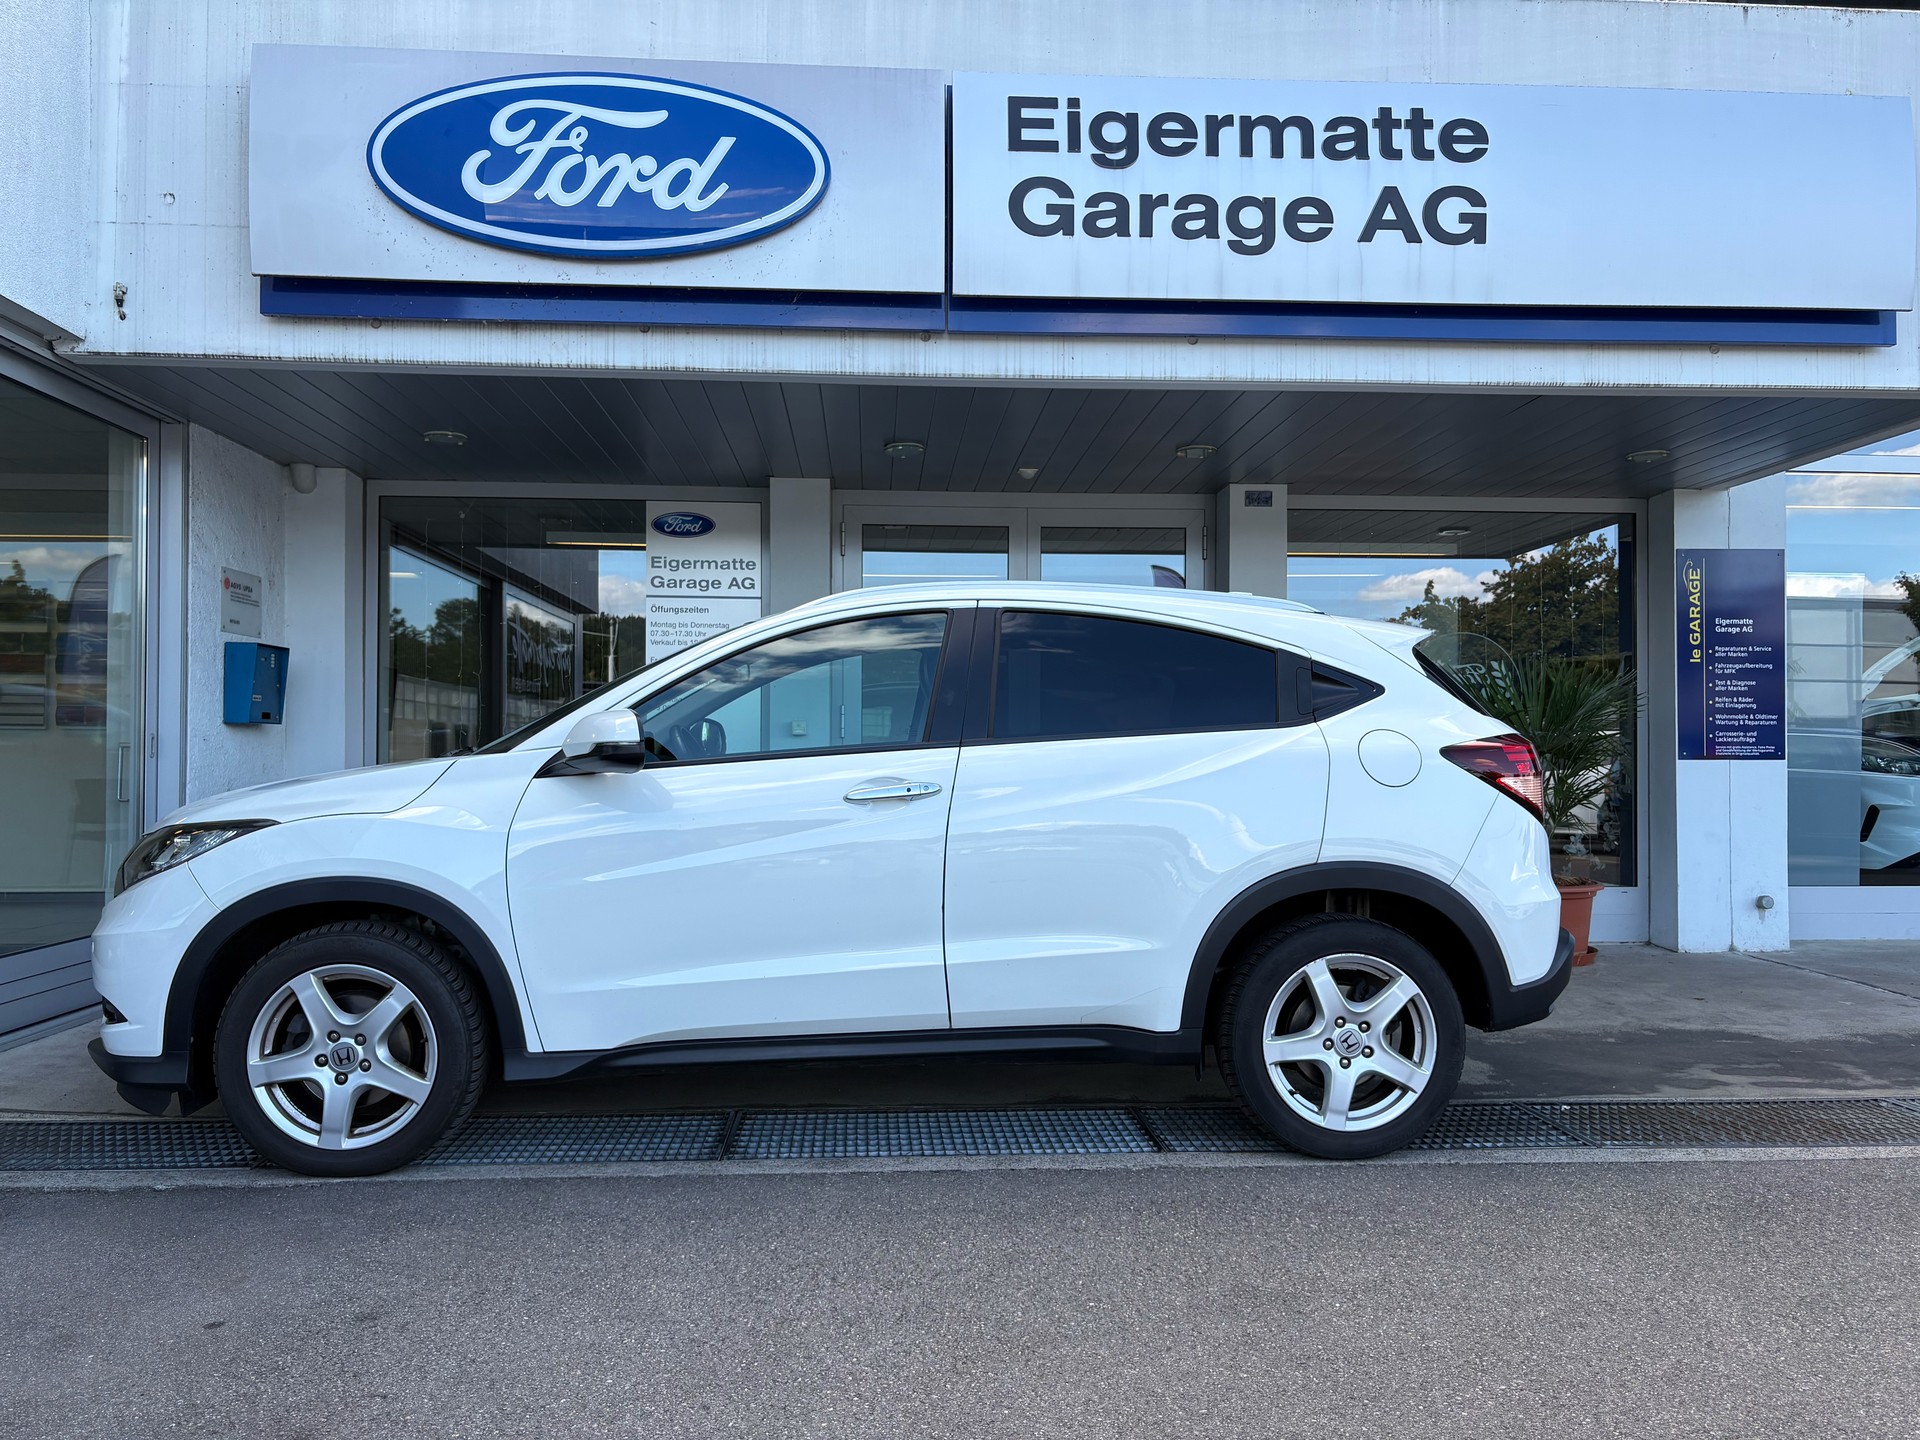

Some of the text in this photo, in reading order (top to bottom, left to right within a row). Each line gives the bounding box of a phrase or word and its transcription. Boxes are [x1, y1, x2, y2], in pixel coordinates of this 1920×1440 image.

[1007, 95, 1490, 169] Eigermatte
[461, 99, 737, 212] Ford
[1007, 176, 1488, 256] Garage AG
[664, 515, 703, 533] Ford
[650, 556, 757, 572] Eigermatte
[650, 575, 756, 592] Garage AG
[650, 604, 710, 615] Öffungszeiten
[1689, 568, 1701, 663] le GARAGE
[650, 622, 677, 630] Montag
[690, 622, 730, 630] Donnerstag
[1715, 618, 1754, 626] Eigermatte
[1715, 626, 1740, 634] Garage
